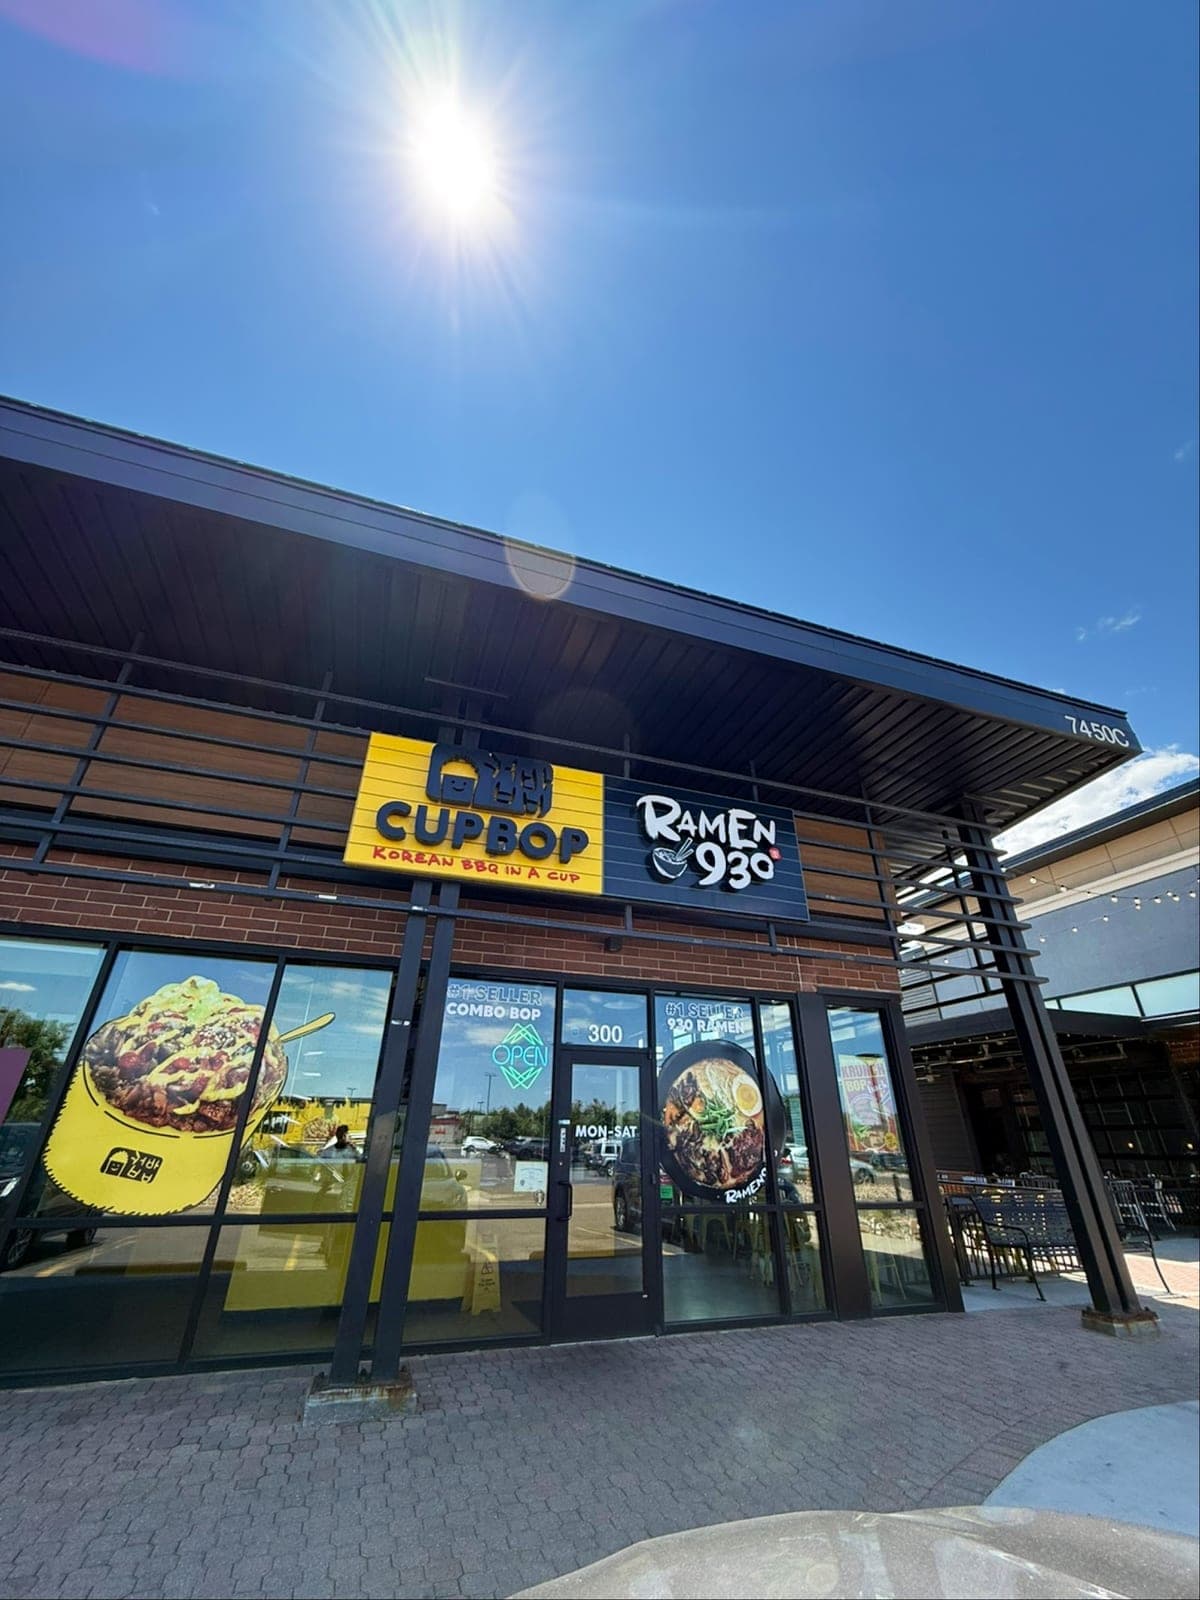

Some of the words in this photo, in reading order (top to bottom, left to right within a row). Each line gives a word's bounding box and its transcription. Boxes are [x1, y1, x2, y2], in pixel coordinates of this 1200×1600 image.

[1064, 715, 1130, 747] 7450C
[376, 801, 590, 865] CUPBOP
[372, 846, 454, 867] KOREAN
[461, 859, 499, 875] BBQ
[506, 865, 522, 876] IN
[527, 867, 540, 879] A
[547, 871, 581, 883] CUP
[695, 841, 775, 890] 930
[474, 985, 542, 1006] SELLER
[446, 1002, 506, 1018] COMBO
[509, 1006, 541, 1021] BOP
[666, 1002, 687, 1018] #1
[688, 1003, 744, 1019] SELLER
[588, 1024, 623, 1044] 300
[667, 1017, 693, 1032] 930
[696, 1018, 744, 1033] RAMEN
[492, 1044, 549, 1067] OPEN
[575, 1124, 638, 1138] MON-SAT
